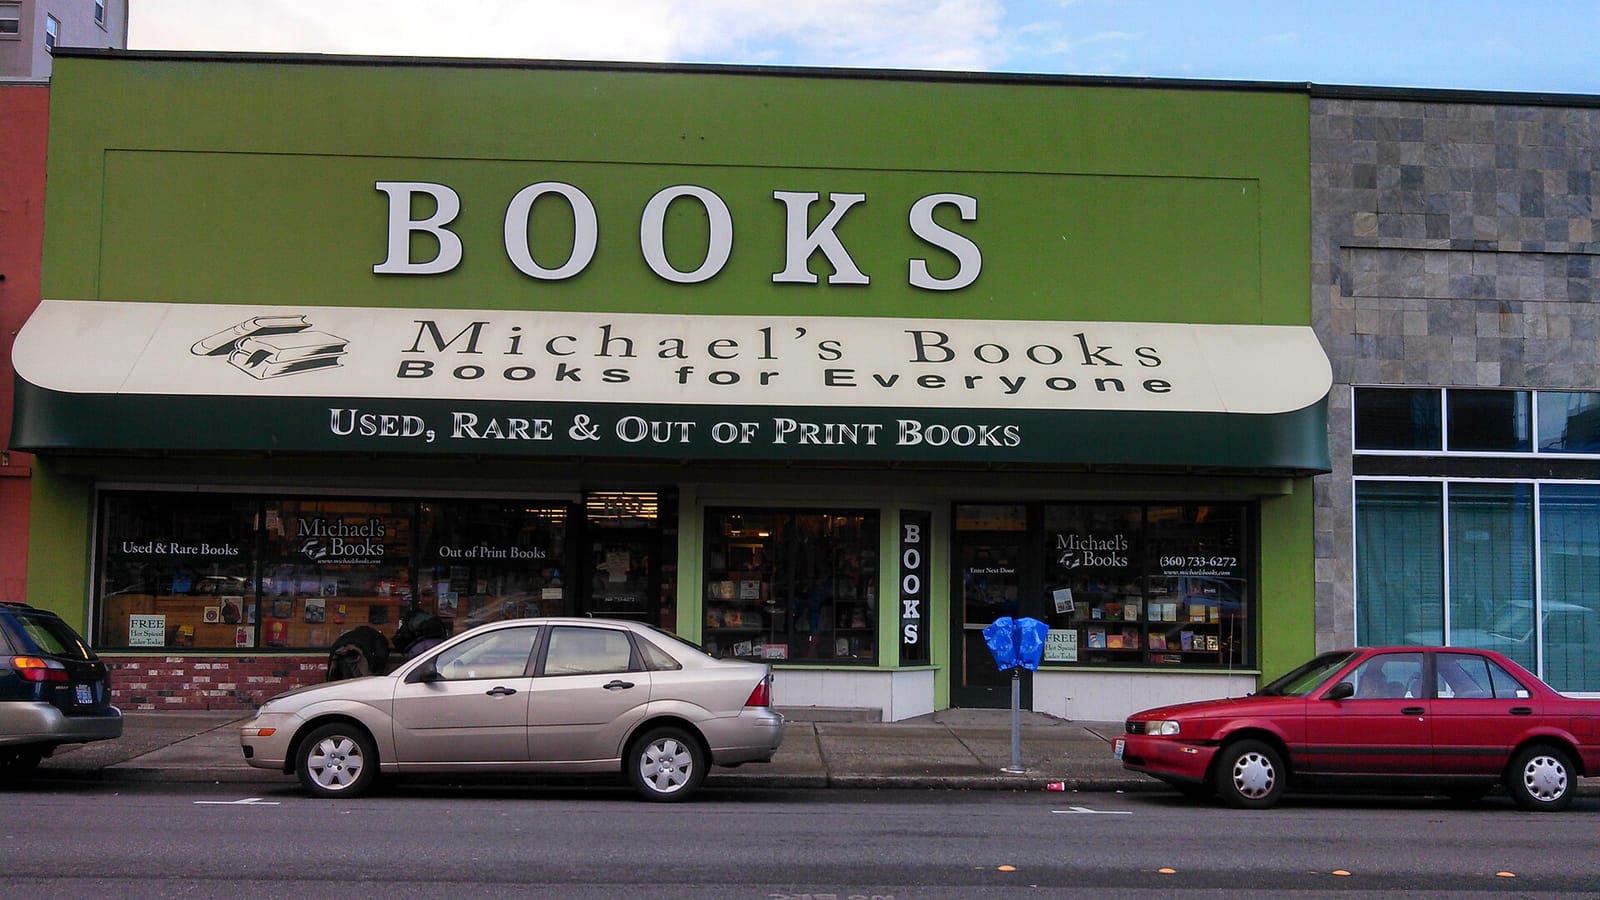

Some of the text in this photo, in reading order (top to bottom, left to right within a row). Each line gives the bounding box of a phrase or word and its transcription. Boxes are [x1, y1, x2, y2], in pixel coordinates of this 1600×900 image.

[372, 179, 984, 291] BOOKS
[400, 319, 1163, 368] Michael's Books
[396, 359, 1172, 395] Books for Everyone
[328, 407, 1021, 447] USED, RARE & OUT OF PRINT BOOKS
[297, 518, 385, 537] Michael's
[122, 541, 239, 556] Used & Rare Books
[329, 537, 384, 556] Books
[1056, 534, 1128, 550] Michael's
[439, 545, 546, 559] Out of Print Books
[1083, 551, 1128, 567] Books
[1159, 556, 1237, 568] (360) 733-6272
[903, 524, 920, 644] BOOKS
[131, 619, 165, 629] FREE
[1046, 633, 1076, 643] FREE
